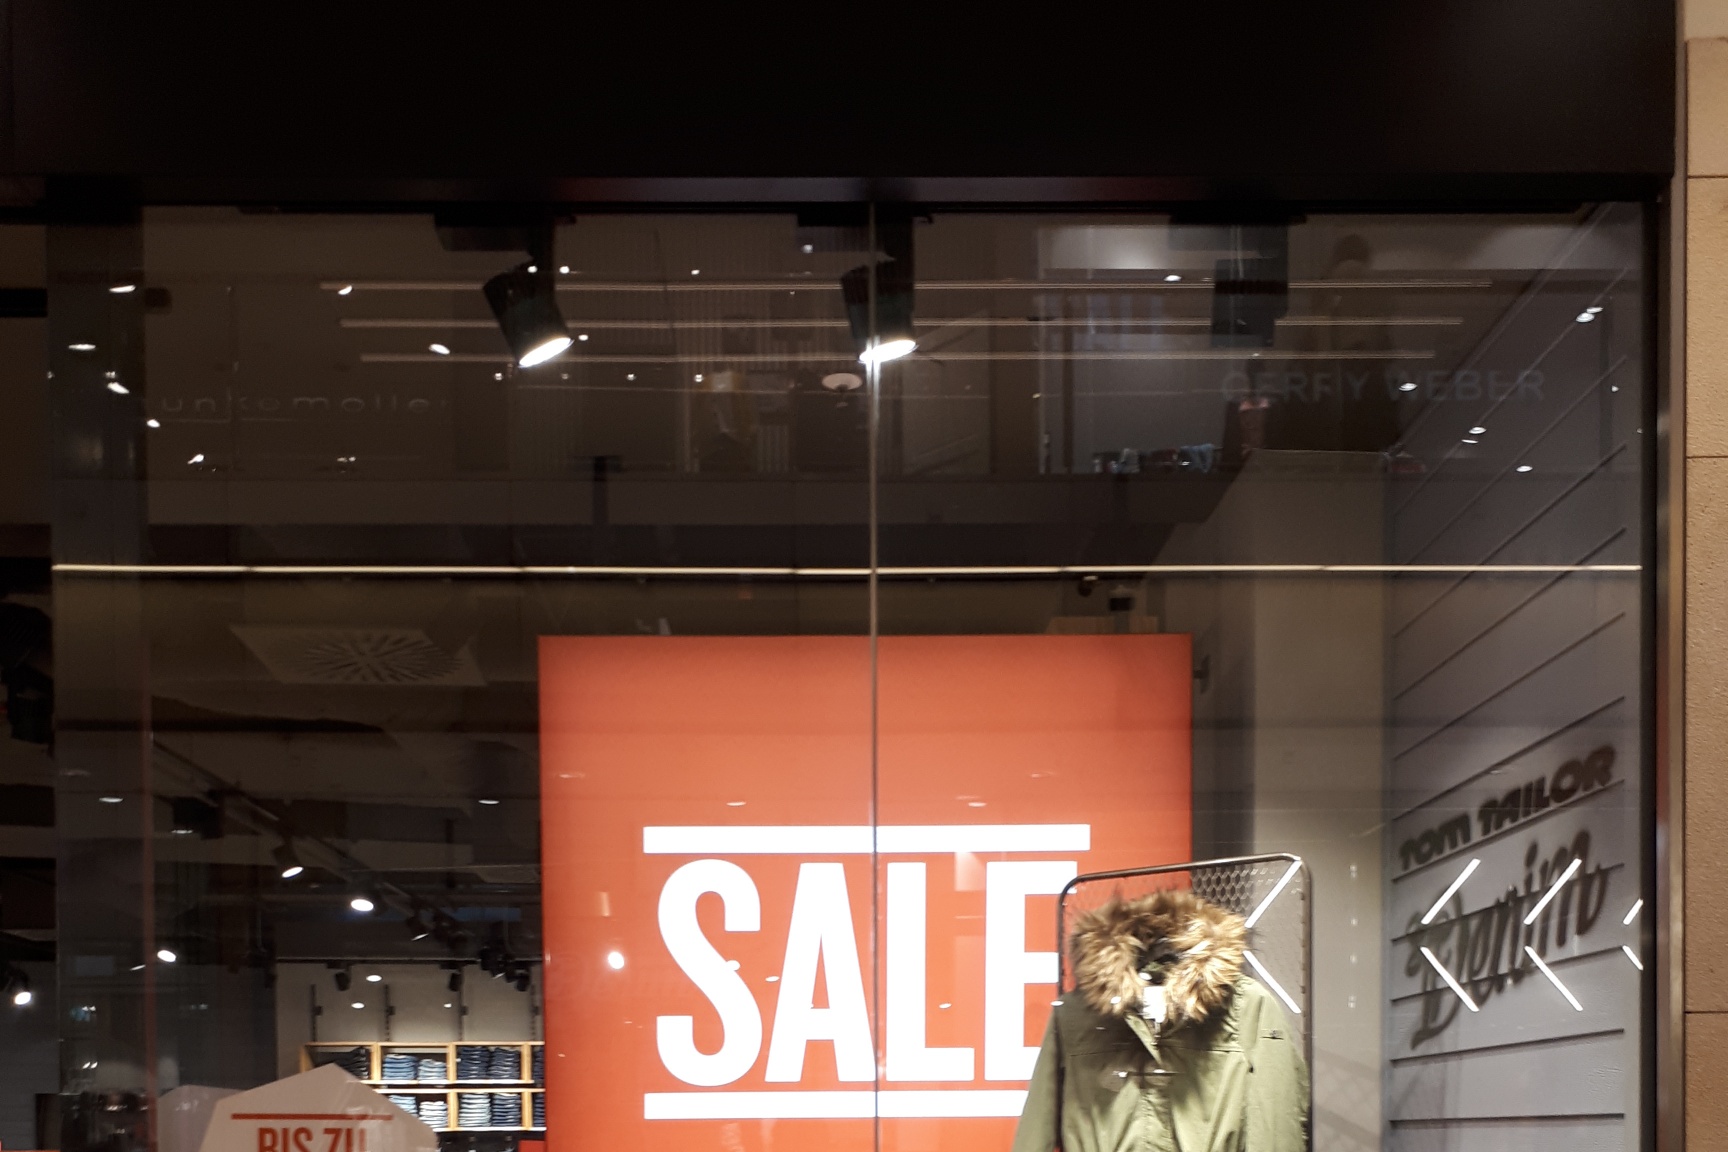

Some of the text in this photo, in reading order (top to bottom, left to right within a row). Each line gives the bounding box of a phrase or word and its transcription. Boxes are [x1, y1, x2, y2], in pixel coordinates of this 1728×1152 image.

[1401, 745, 1617, 871] TOM TAILOR
[655, 858, 1077, 1087] SALE
